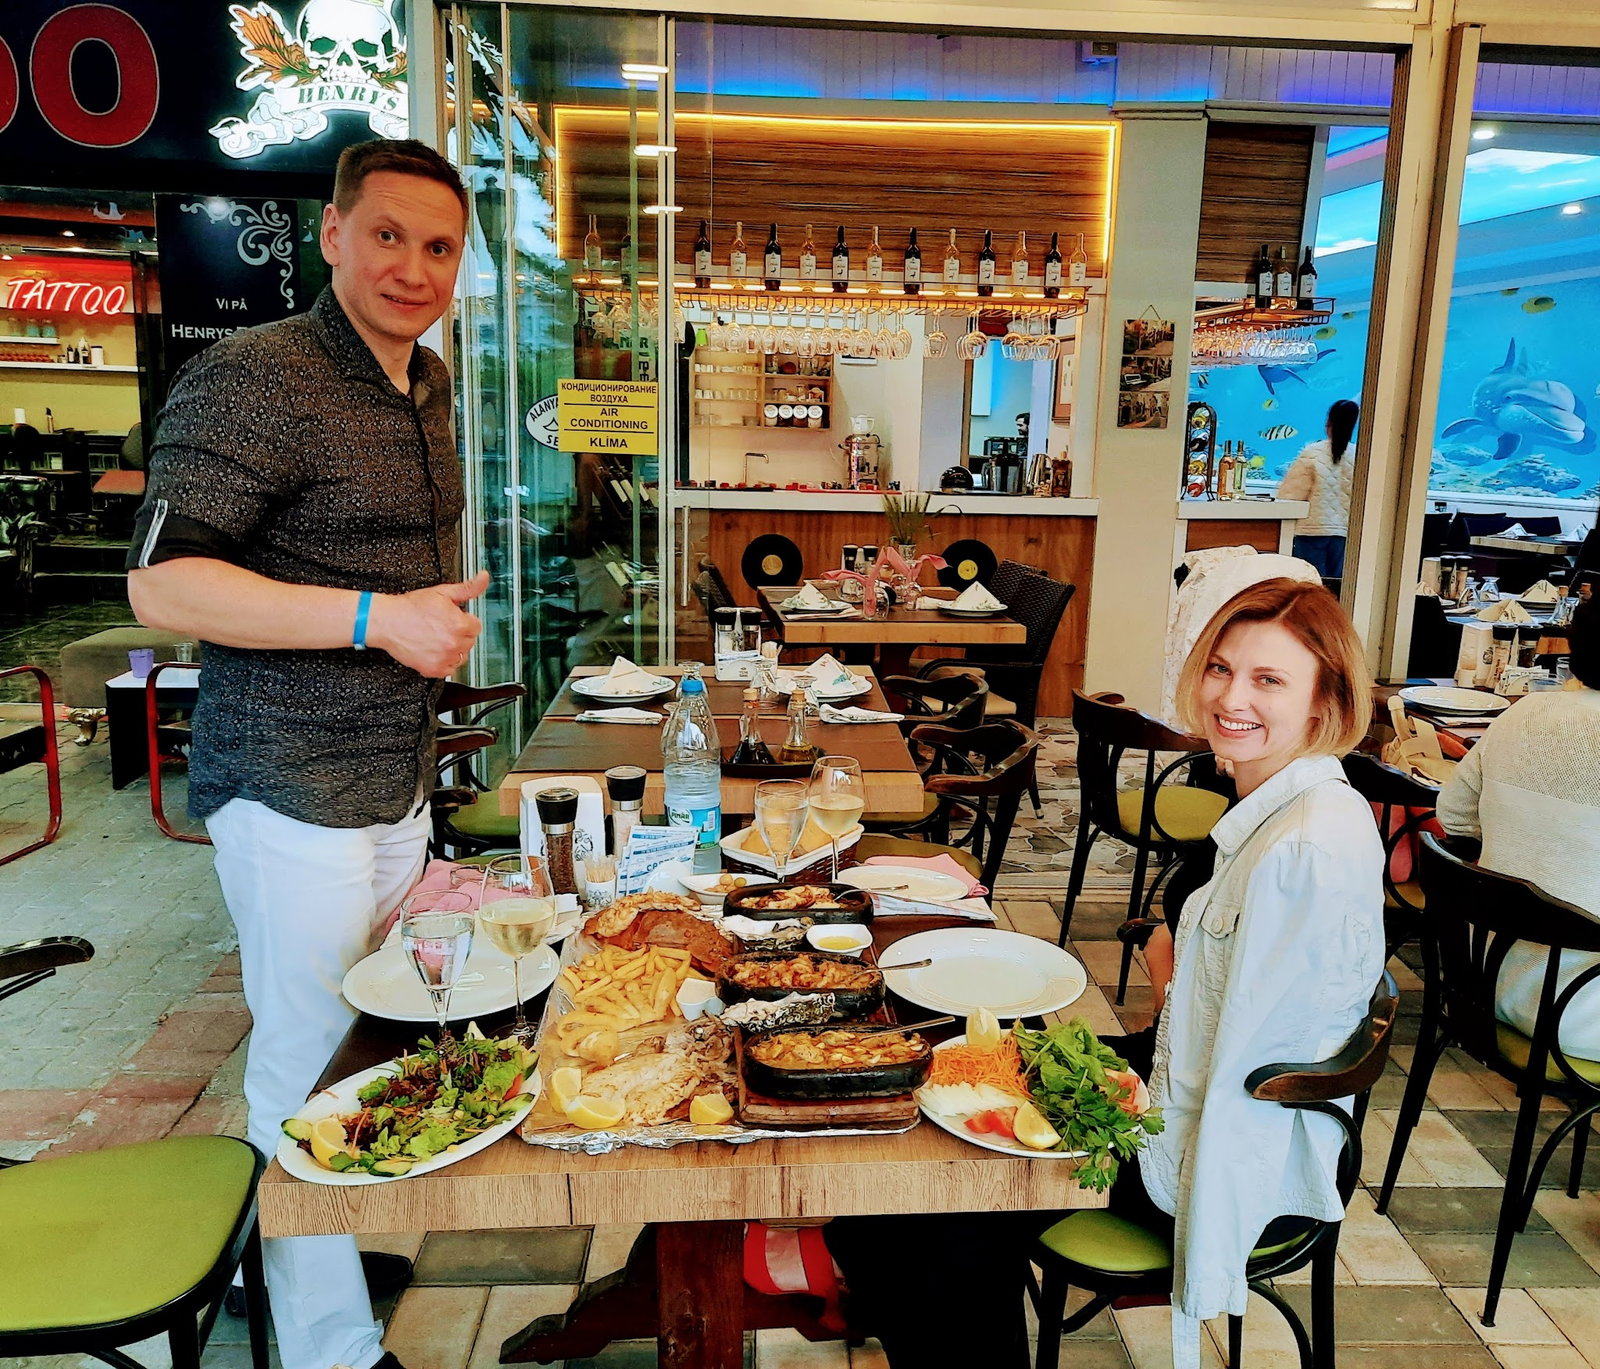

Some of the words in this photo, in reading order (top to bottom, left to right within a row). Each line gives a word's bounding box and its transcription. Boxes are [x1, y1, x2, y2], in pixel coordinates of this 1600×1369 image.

[0, 3, 160, 148] O
[298, 84, 400, 111] HENRYS
[7, 279, 126, 315] TATTOO
[561, 382, 657, 394] КОНДИЦИОНИРОВАНИЕ
[590, 394, 629, 404] ВОЗДУХА
[600, 407, 619, 417] AIR
[570, 418, 648, 430] CONDITIONING
[589, 435, 628, 448] KLİMA
